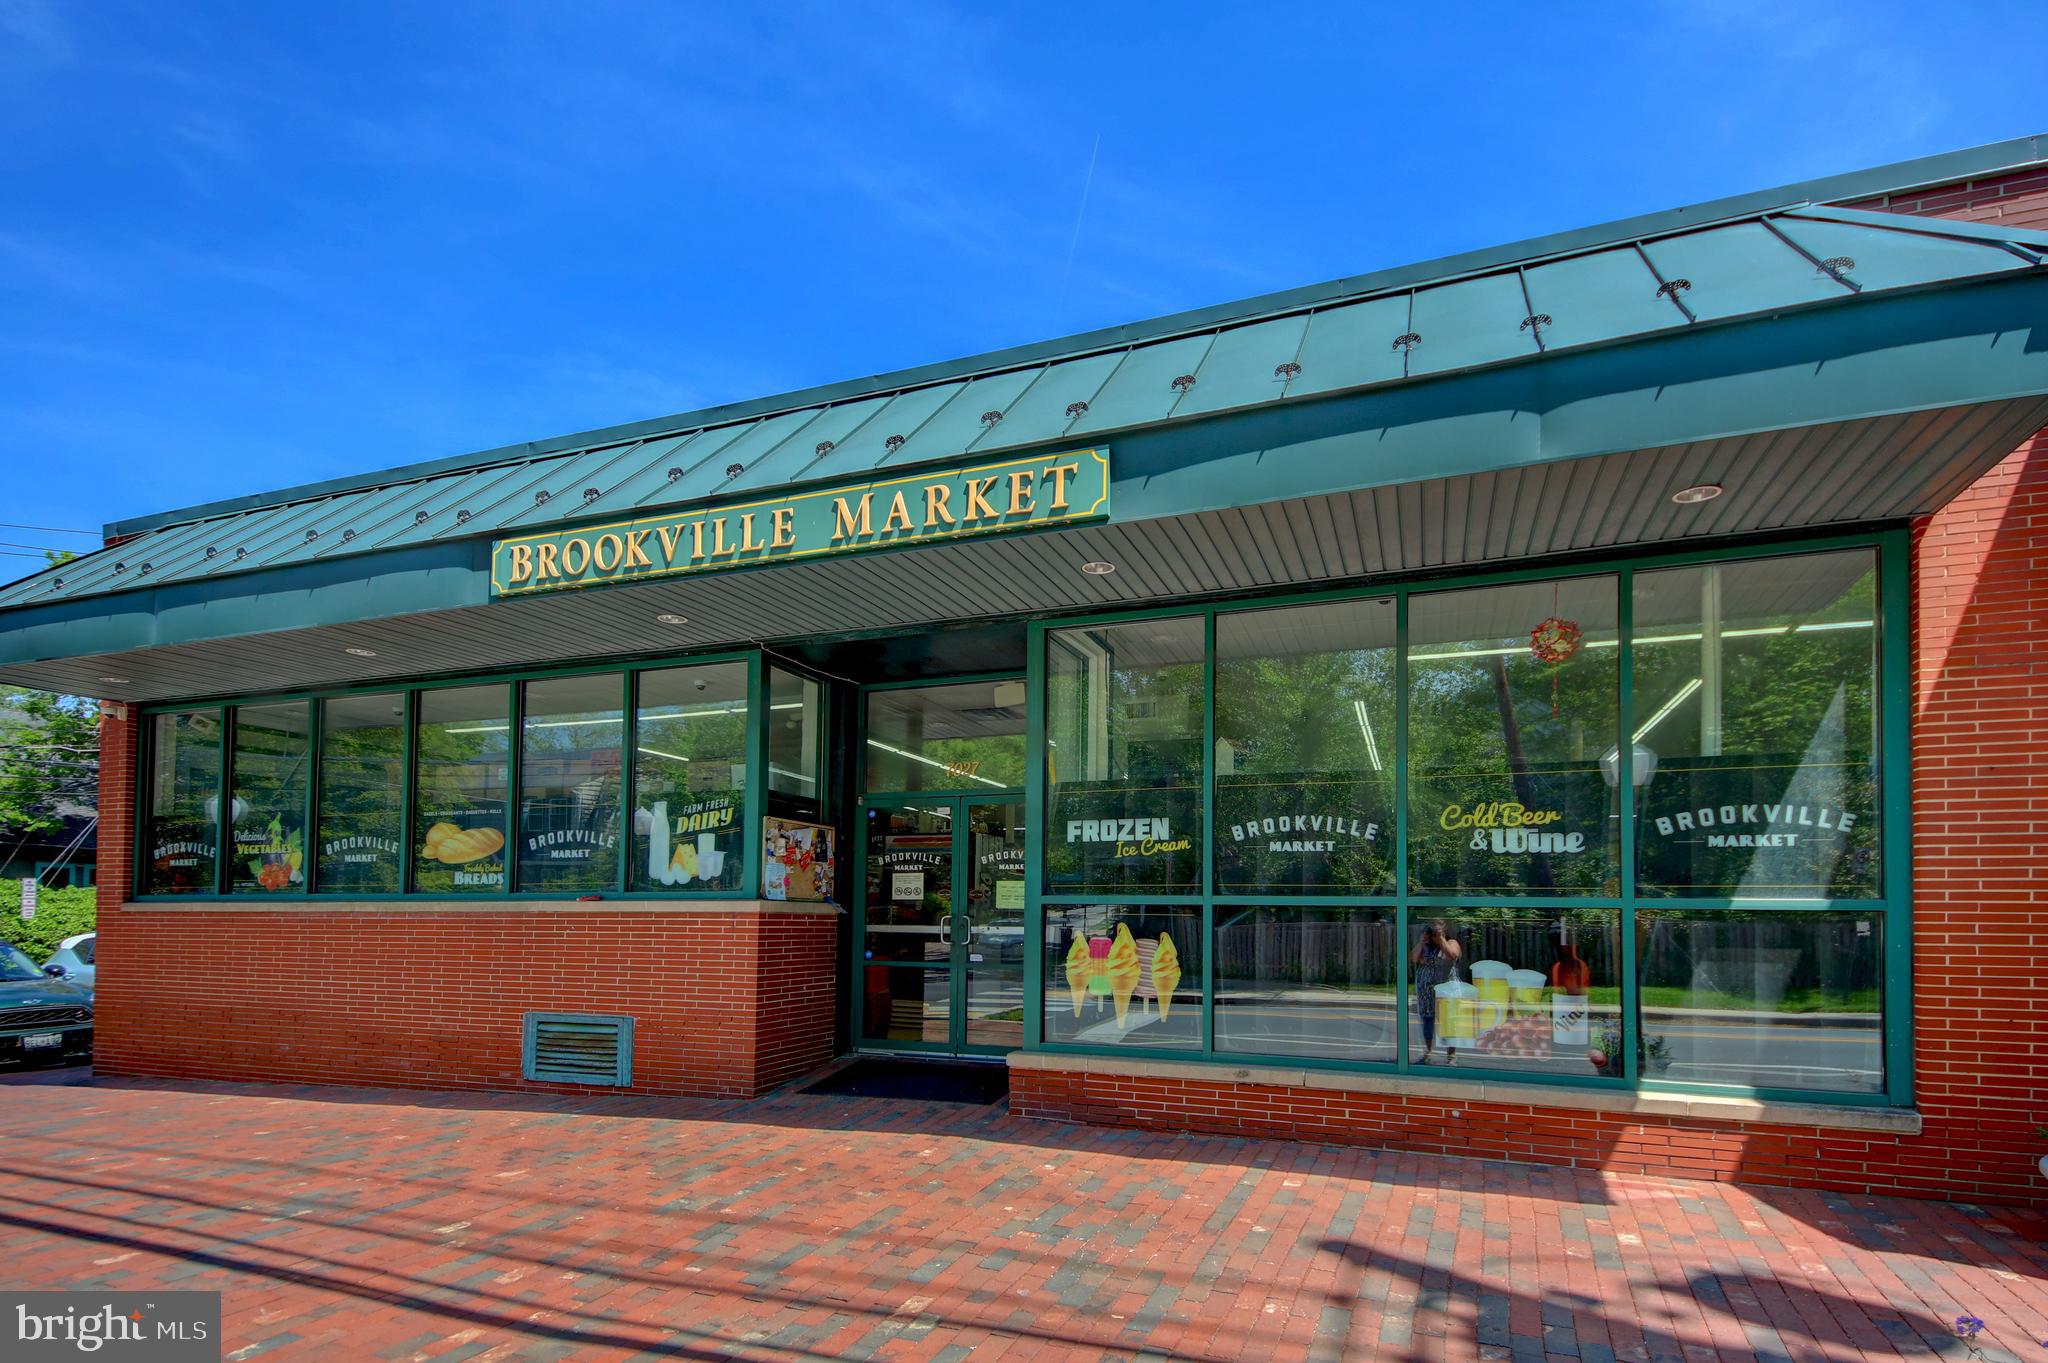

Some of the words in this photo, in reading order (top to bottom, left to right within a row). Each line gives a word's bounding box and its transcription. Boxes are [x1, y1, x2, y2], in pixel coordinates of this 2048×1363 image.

[511, 507, 796, 583] BROOKVILLE
[831, 462, 1079, 540] MARKET
[945, 761, 979, 778] 7027
[683, 803, 703, 815] FARM
[705, 797, 729, 811] FRESH
[676, 807, 735, 834] DAIRY
[1440, 802, 1498, 830] Cold
[1499, 802, 1562, 827] Beer
[1655, 803, 1857, 836] BROOKVILLE
[233, 831, 266, 842] Delicious
[1067, 817, 1169, 842] FROZEN
[1231, 814, 1380, 842] BROOKVILLE
[326, 836, 400, 855] BROOKVILLE
[528, 830, 616, 851] BROOKVILLE
[1115, 840, 1139, 858] Ice
[1140, 837, 1191, 856] Cream
[1269, 840, 1336, 852] MARKET
[1470, 828, 1488, 851] &
[1489, 826, 1586, 854] Wine
[1707, 834, 1799, 848] MARKET
[154, 842, 216, 860] BROOKVILLE
[345, 854, 378, 863] MARKET
[550, 849, 591, 858] MARKET
[878, 852, 941, 865] BROOKVILLE
[981, 851, 1024, 865] BROOKV
[169, 858, 198, 866] MARKET
